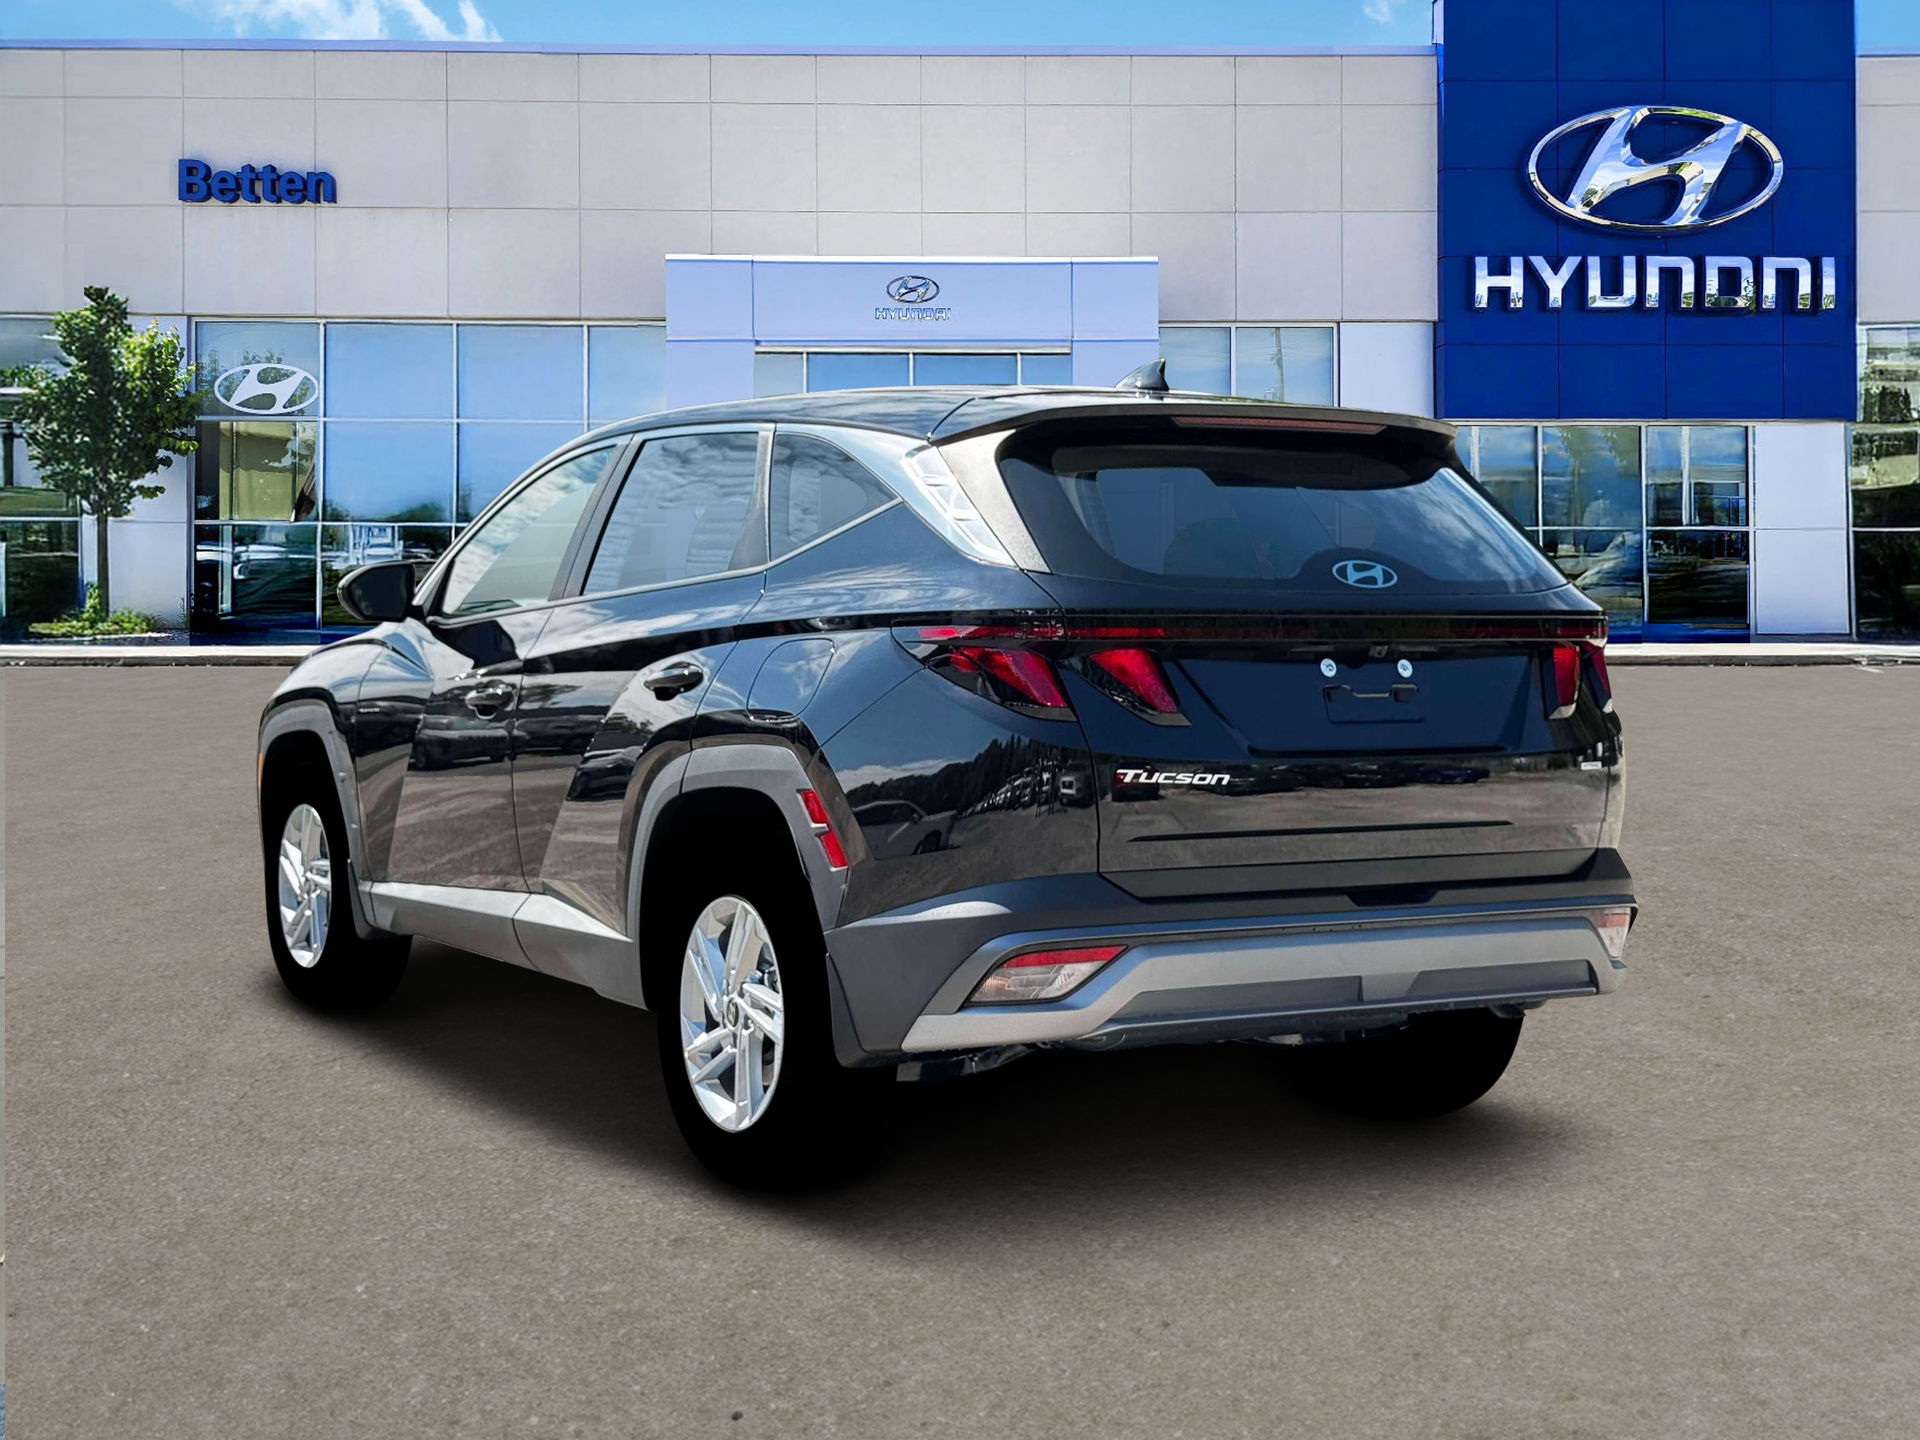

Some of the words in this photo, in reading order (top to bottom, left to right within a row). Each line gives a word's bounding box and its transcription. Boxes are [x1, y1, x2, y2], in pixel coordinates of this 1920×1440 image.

[178, 159, 337, 204] Betten
[1474, 255, 1836, 310] HYUNDAI
[874, 307, 952, 321] HYUNDAI
